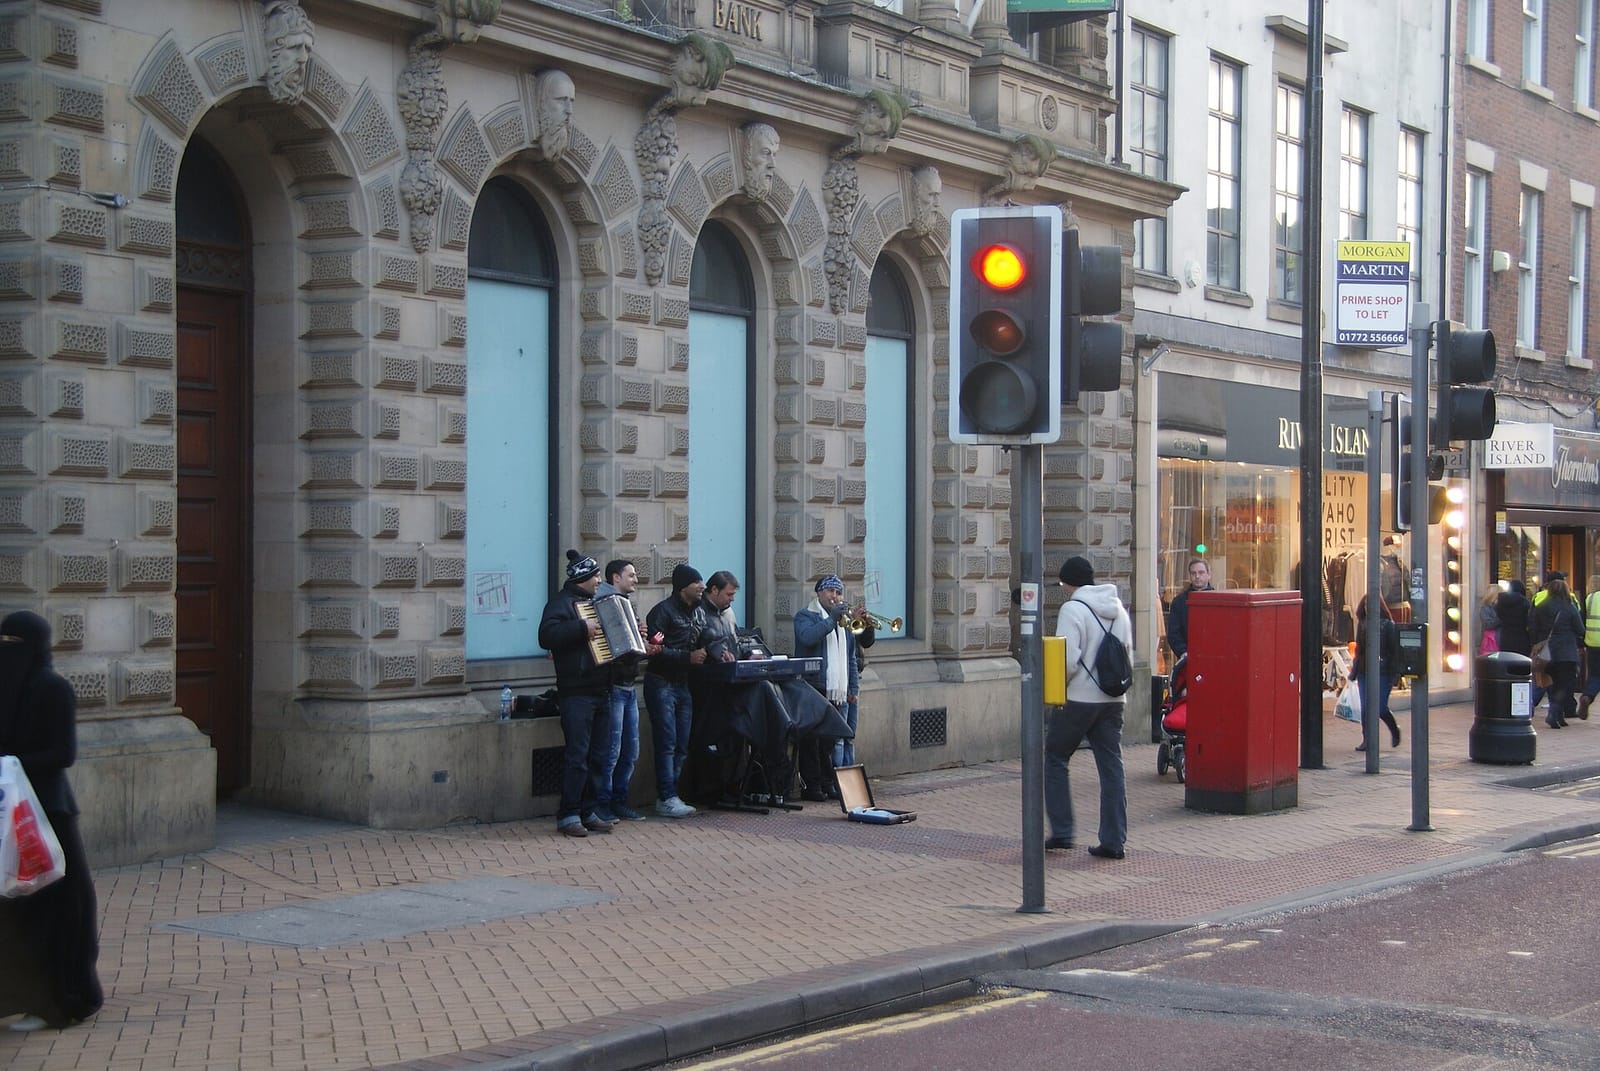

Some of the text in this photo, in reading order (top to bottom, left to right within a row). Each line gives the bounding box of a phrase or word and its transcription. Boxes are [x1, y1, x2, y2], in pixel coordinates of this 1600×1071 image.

[713, 0, 762, 41] BANK
[1343, 245, 1405, 257] MORGAN
[1342, 263, 1404, 276] MARTIN
[1341, 295, 1403, 305] PRIME SHOP
[1355, 310, 1389, 319] TO LET
[1339, 333, 1405, 343] 01772 556666
[1329, 423, 1369, 456] ISLAN
[1490, 440, 1535, 452] RIVER
[1490, 453, 1546, 465] ISLAND
